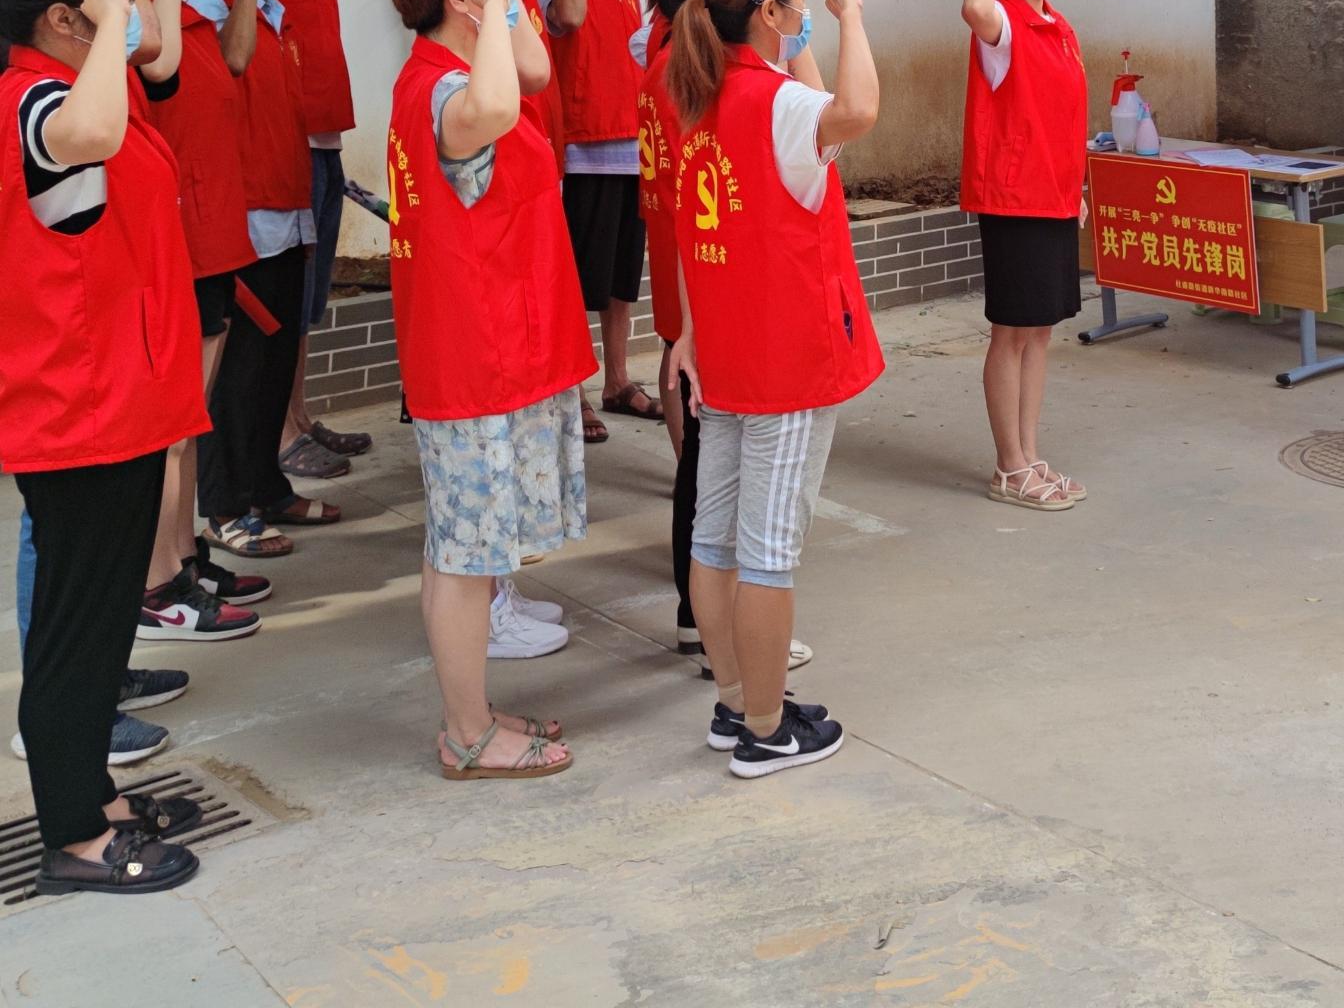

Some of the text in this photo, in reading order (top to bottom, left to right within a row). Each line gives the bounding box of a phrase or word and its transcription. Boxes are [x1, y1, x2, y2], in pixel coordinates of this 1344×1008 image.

[1102, 225, 1246, 281] 共产党员先锋岗
